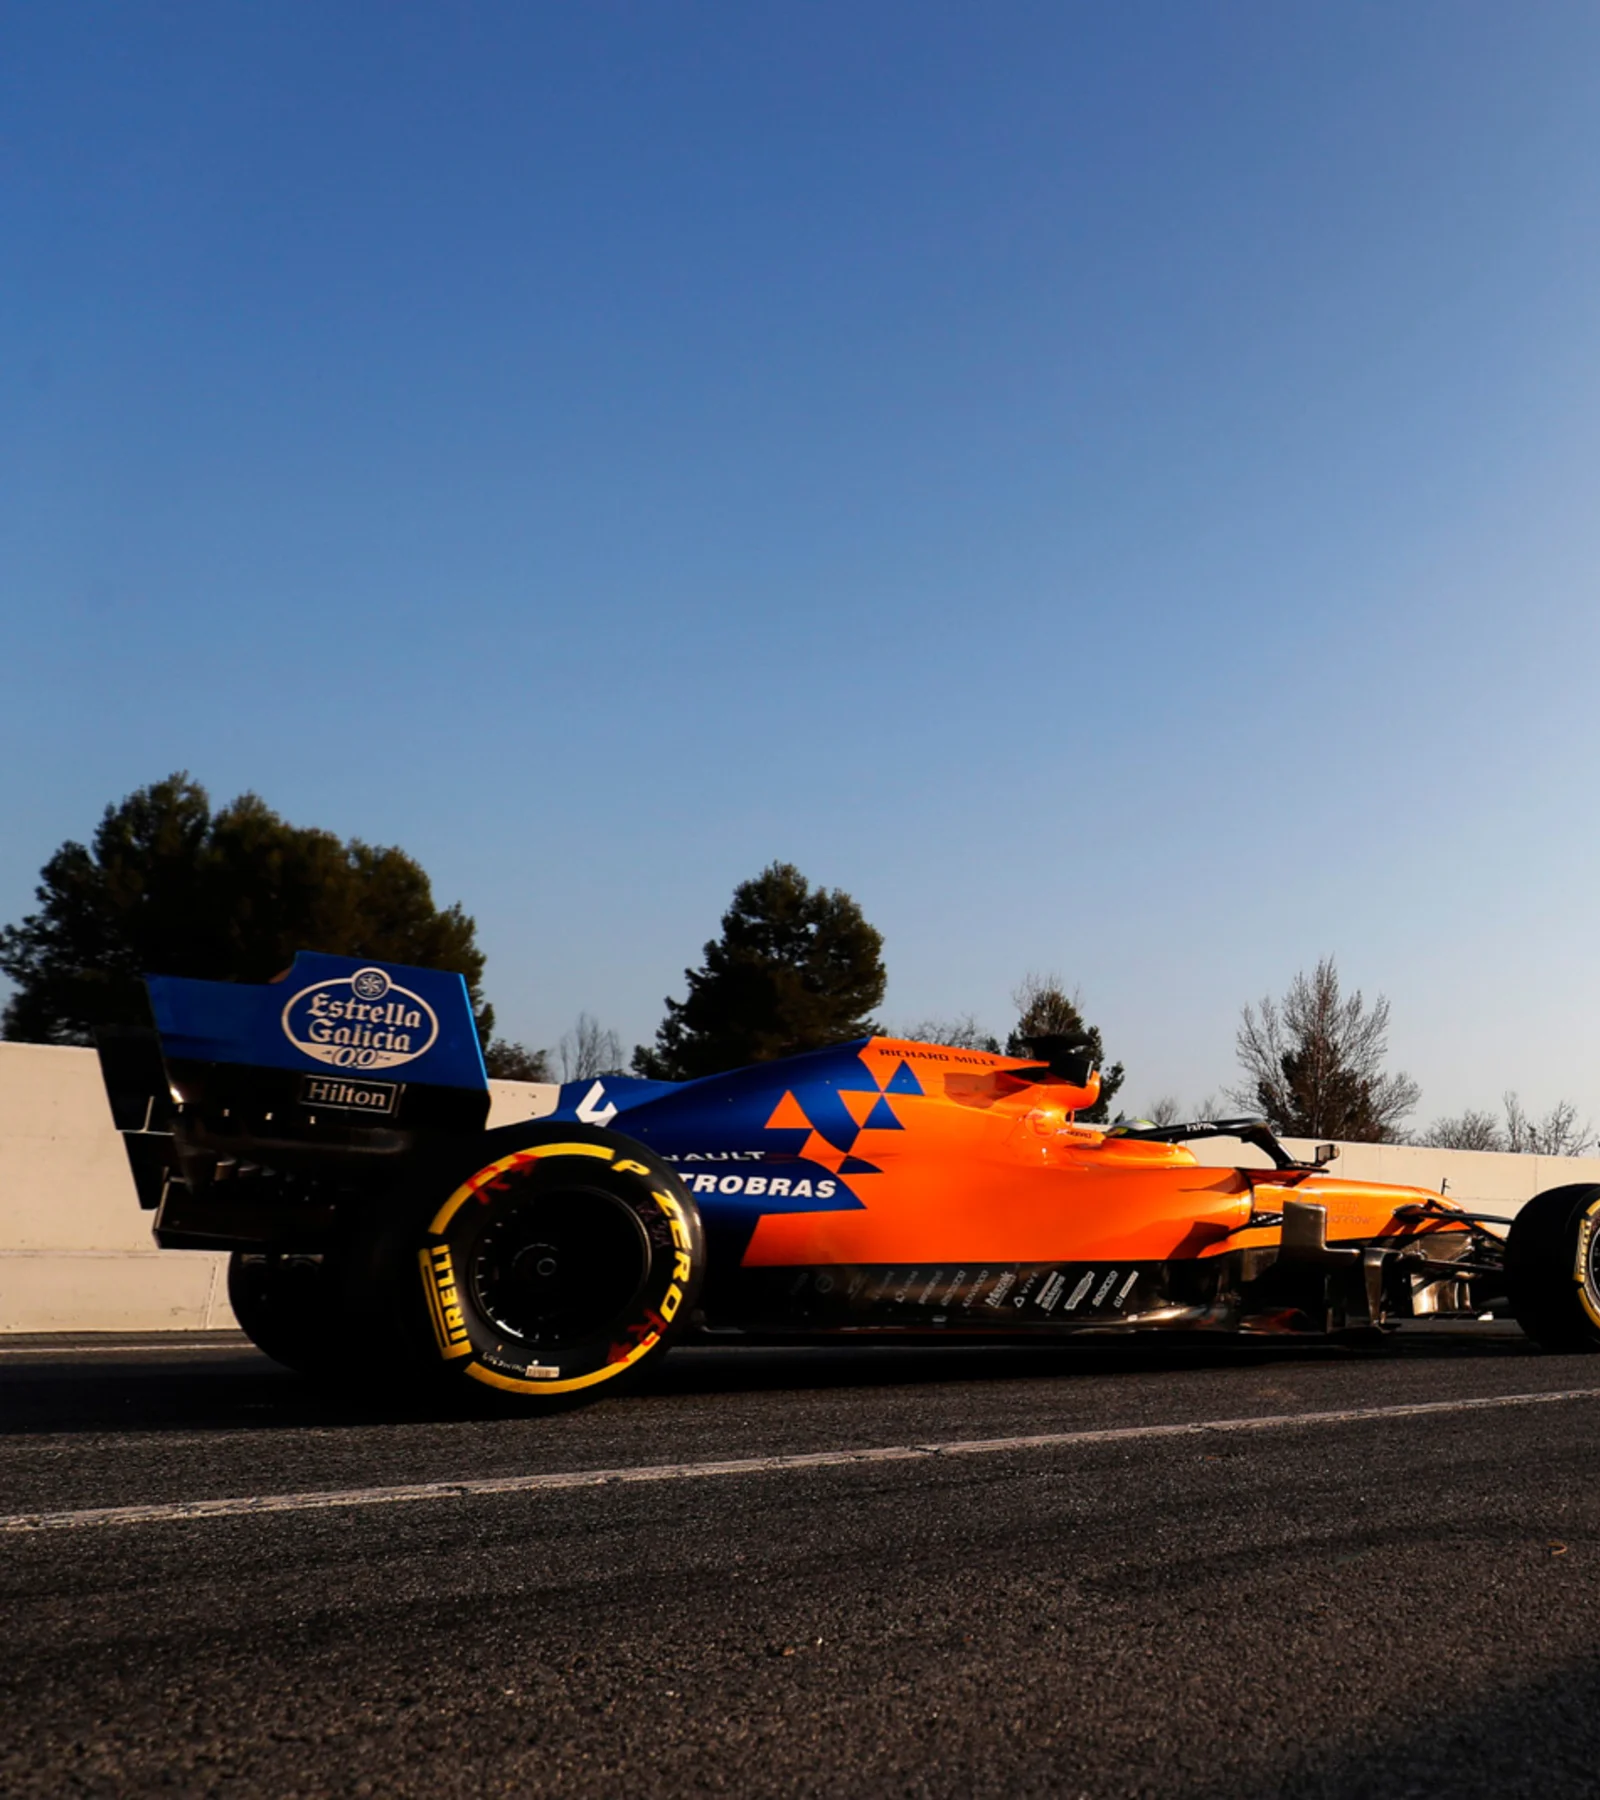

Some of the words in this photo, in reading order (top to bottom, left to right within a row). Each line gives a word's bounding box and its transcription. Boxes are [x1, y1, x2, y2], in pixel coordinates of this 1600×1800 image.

[305, 992, 422, 1029] Estrella
[307, 1018, 411, 1052] Galicia
[878, 1048, 949, 1062] RICHARD
[954, 1055, 997, 1067] MILLE
[307, 1081, 387, 1108] Hilton
[611, 1159, 651, 1177] P
[651, 1189, 693, 1323] ZERO
[417, 1243, 473, 1360] PIRELLI
